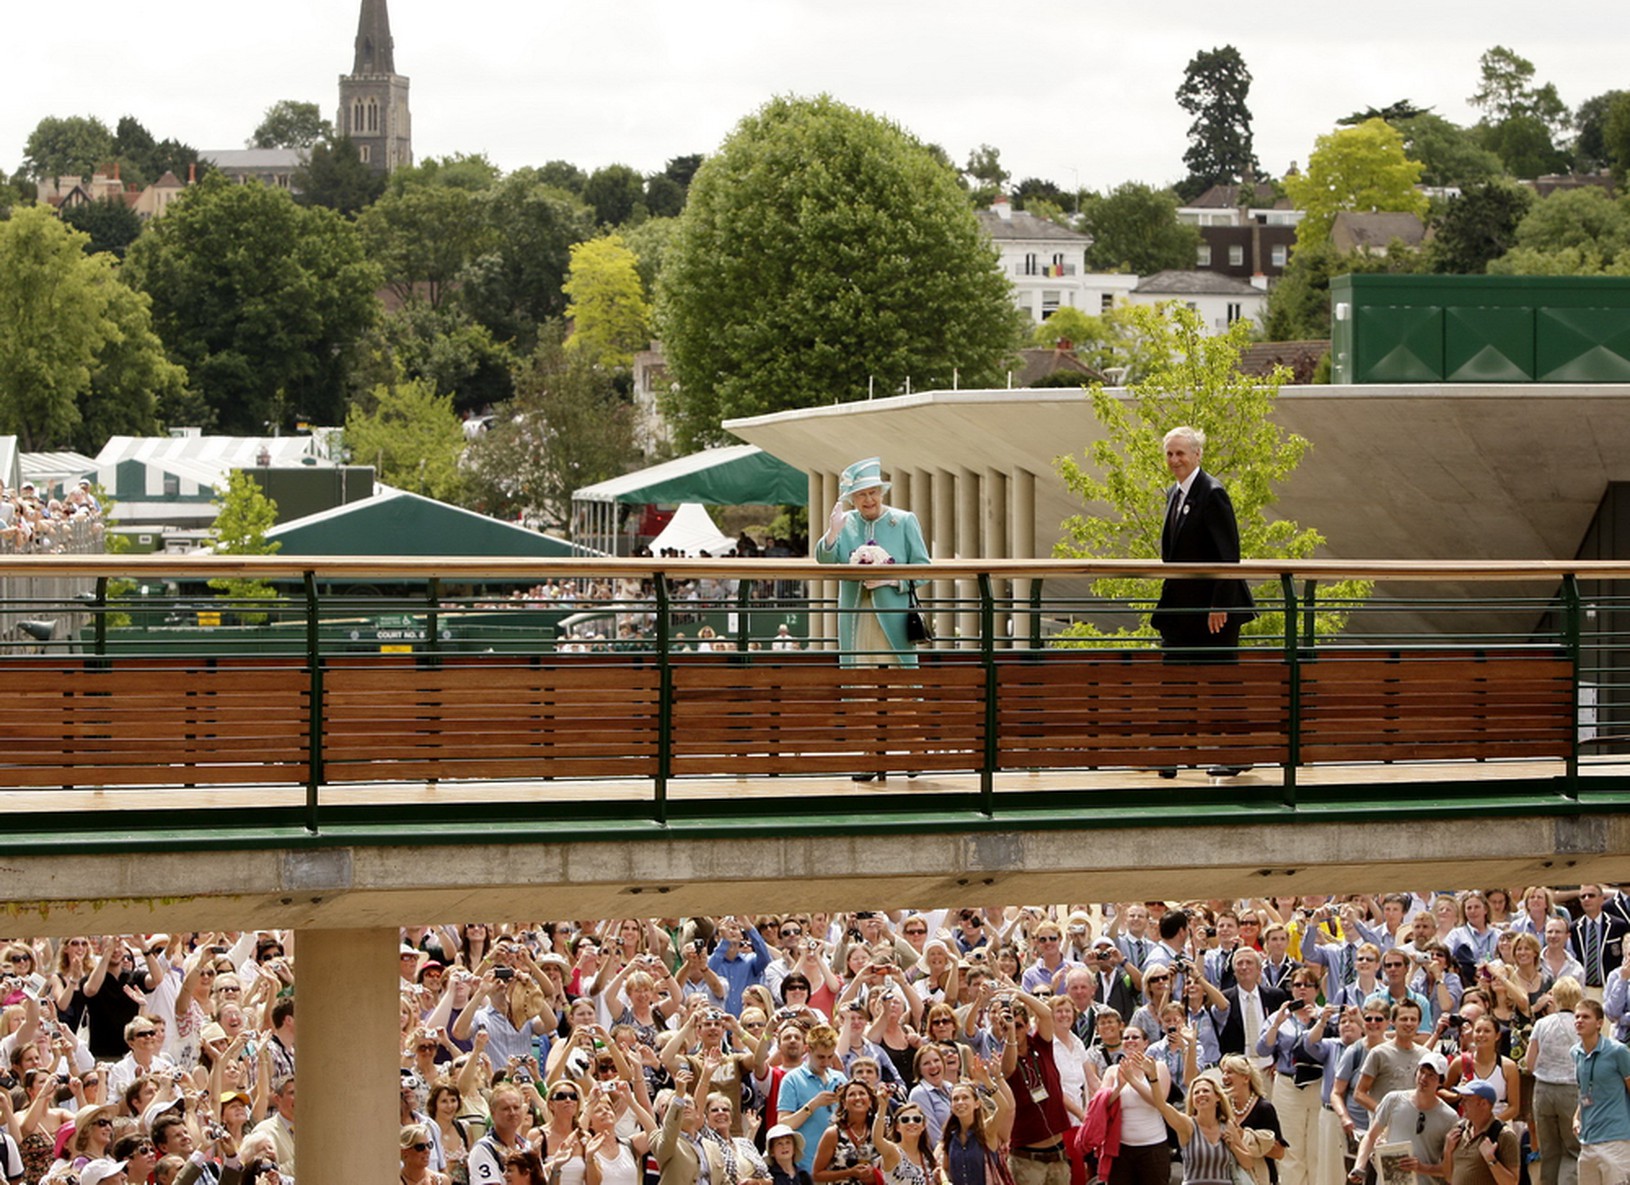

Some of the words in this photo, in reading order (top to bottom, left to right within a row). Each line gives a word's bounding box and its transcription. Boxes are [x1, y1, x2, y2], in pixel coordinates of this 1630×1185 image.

[787, 614, 797, 624] 12
[377, 631, 402, 639] COURT
[479, 1164, 491, 1178] 3
